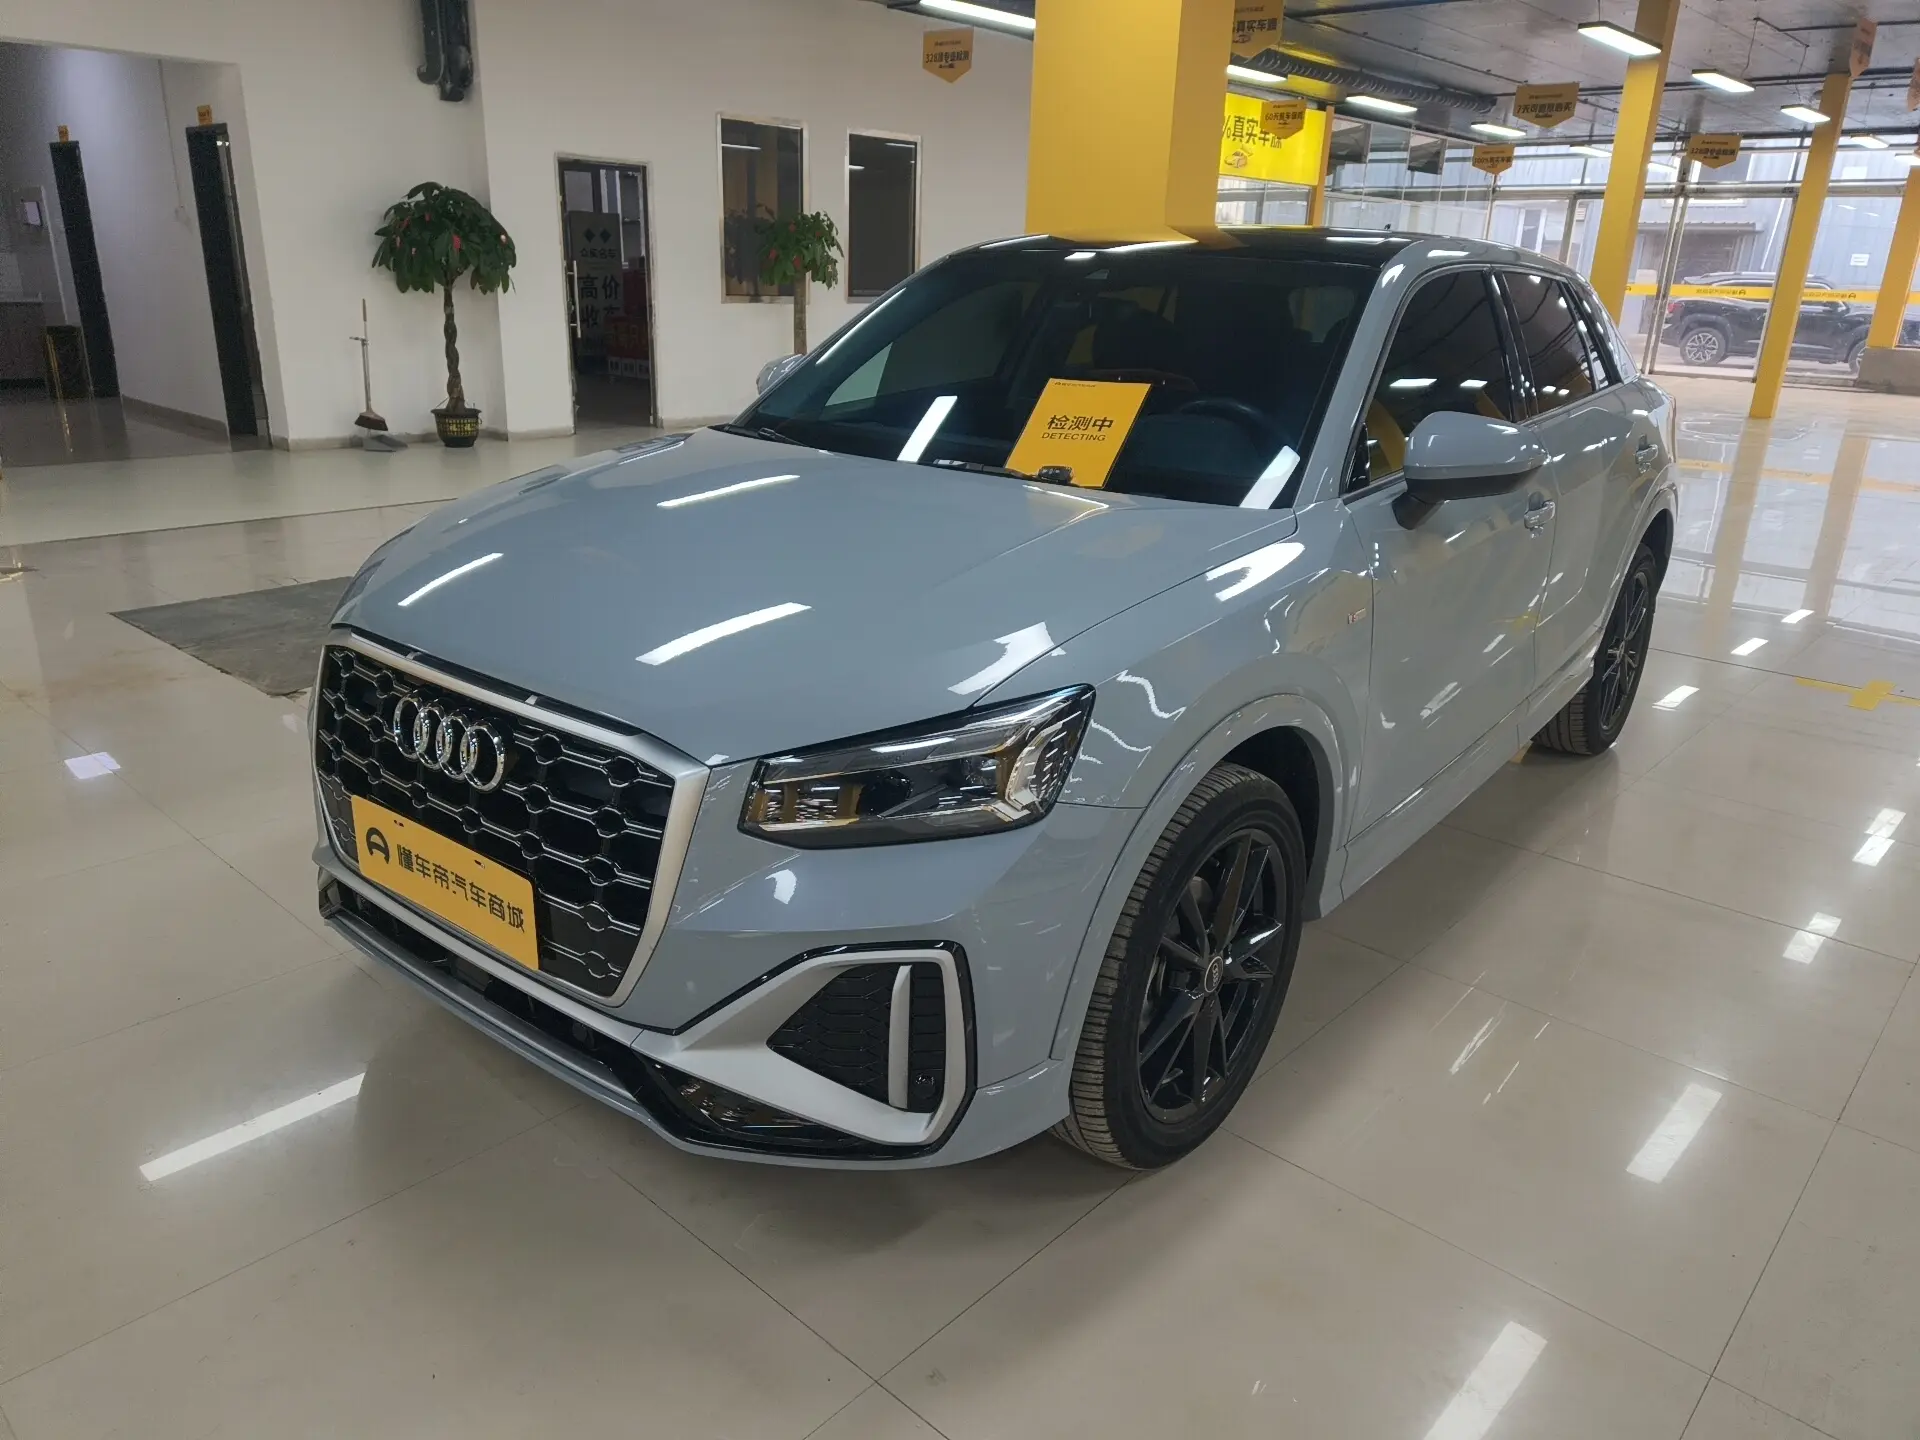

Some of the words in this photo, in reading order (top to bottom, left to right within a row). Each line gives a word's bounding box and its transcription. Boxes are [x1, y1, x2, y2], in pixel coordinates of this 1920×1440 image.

[577, 273, 620, 300] 高价
[1047, 414, 1114, 432] 检测中
[1041, 432, 1106, 442] DETECTING
[397, 843, 525, 933] 懂车帝汽车商城
